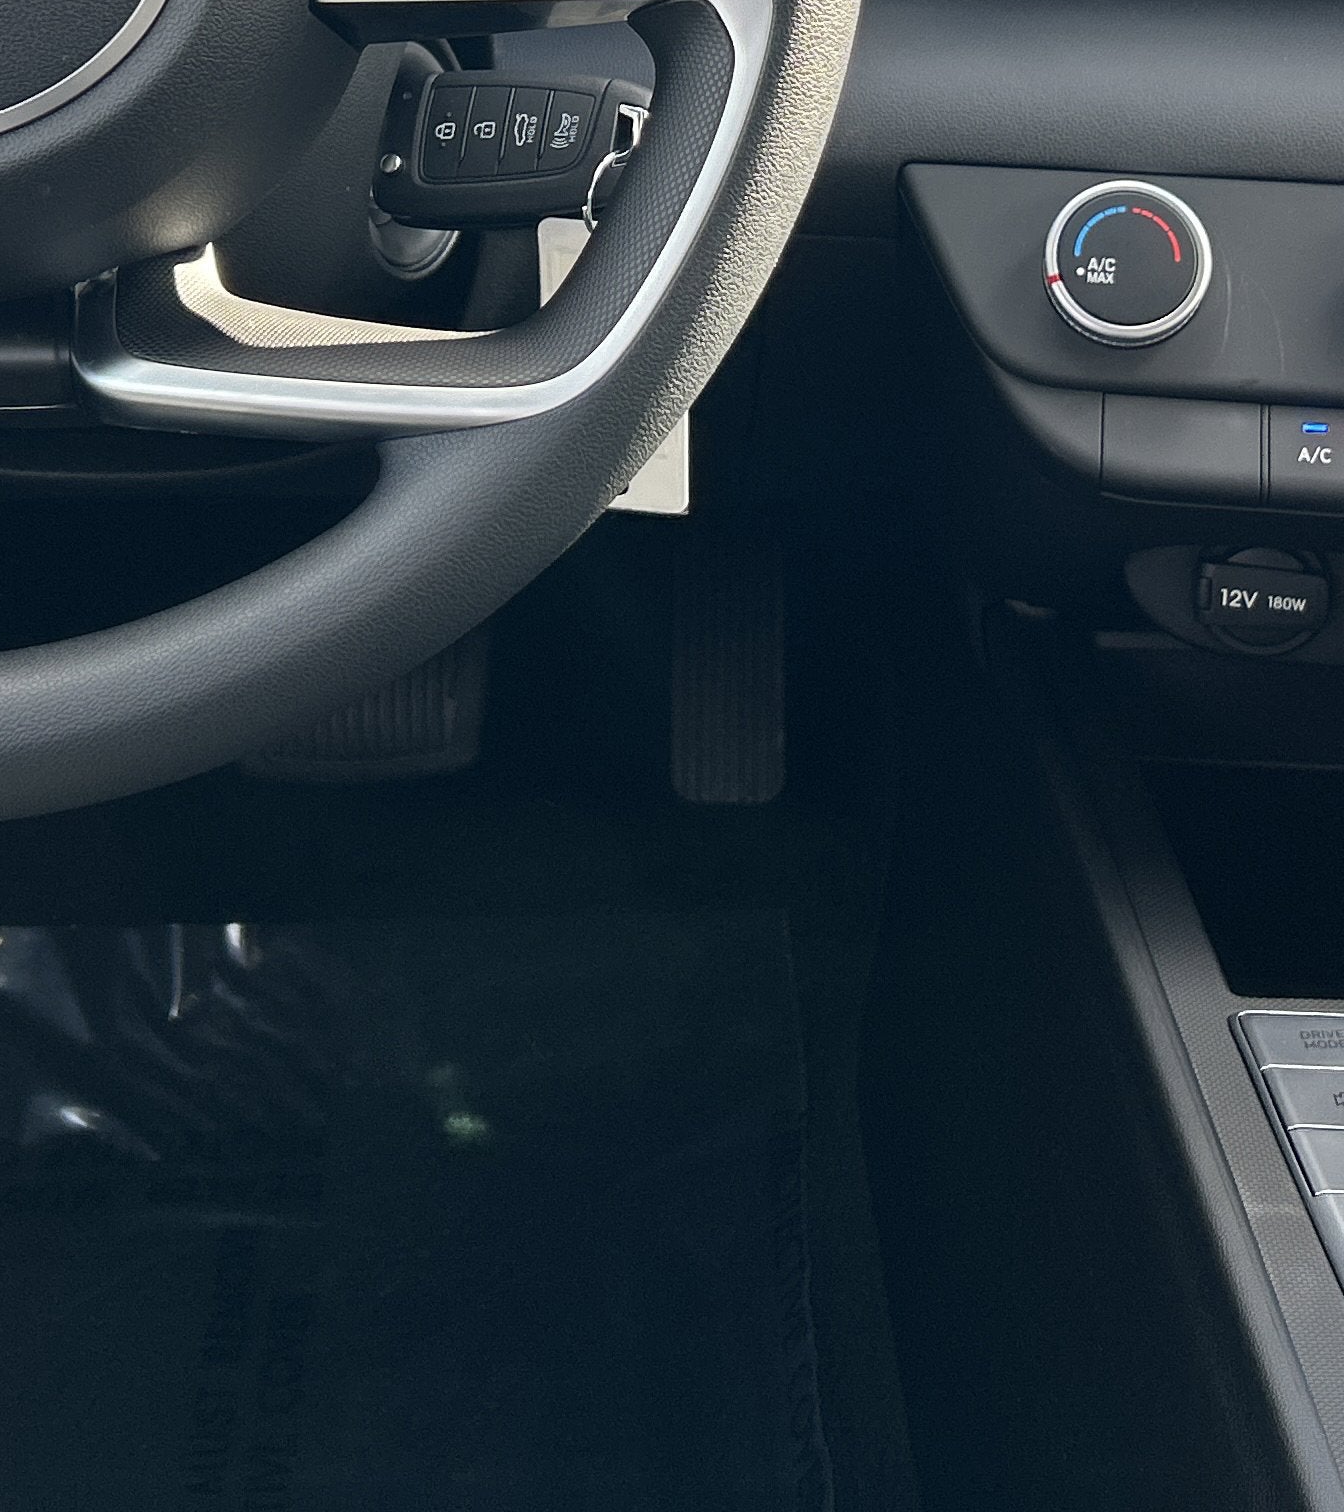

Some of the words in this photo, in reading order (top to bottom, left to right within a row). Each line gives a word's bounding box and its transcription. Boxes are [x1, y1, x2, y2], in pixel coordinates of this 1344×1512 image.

[1087, 257, 1116, 273] A/C
[1086, 271, 1114, 285] MAX
[1297, 445, 1332, 464] A/C
[1220, 588, 1259, 609] 12V
[1267, 595, 1307, 612] 180W
